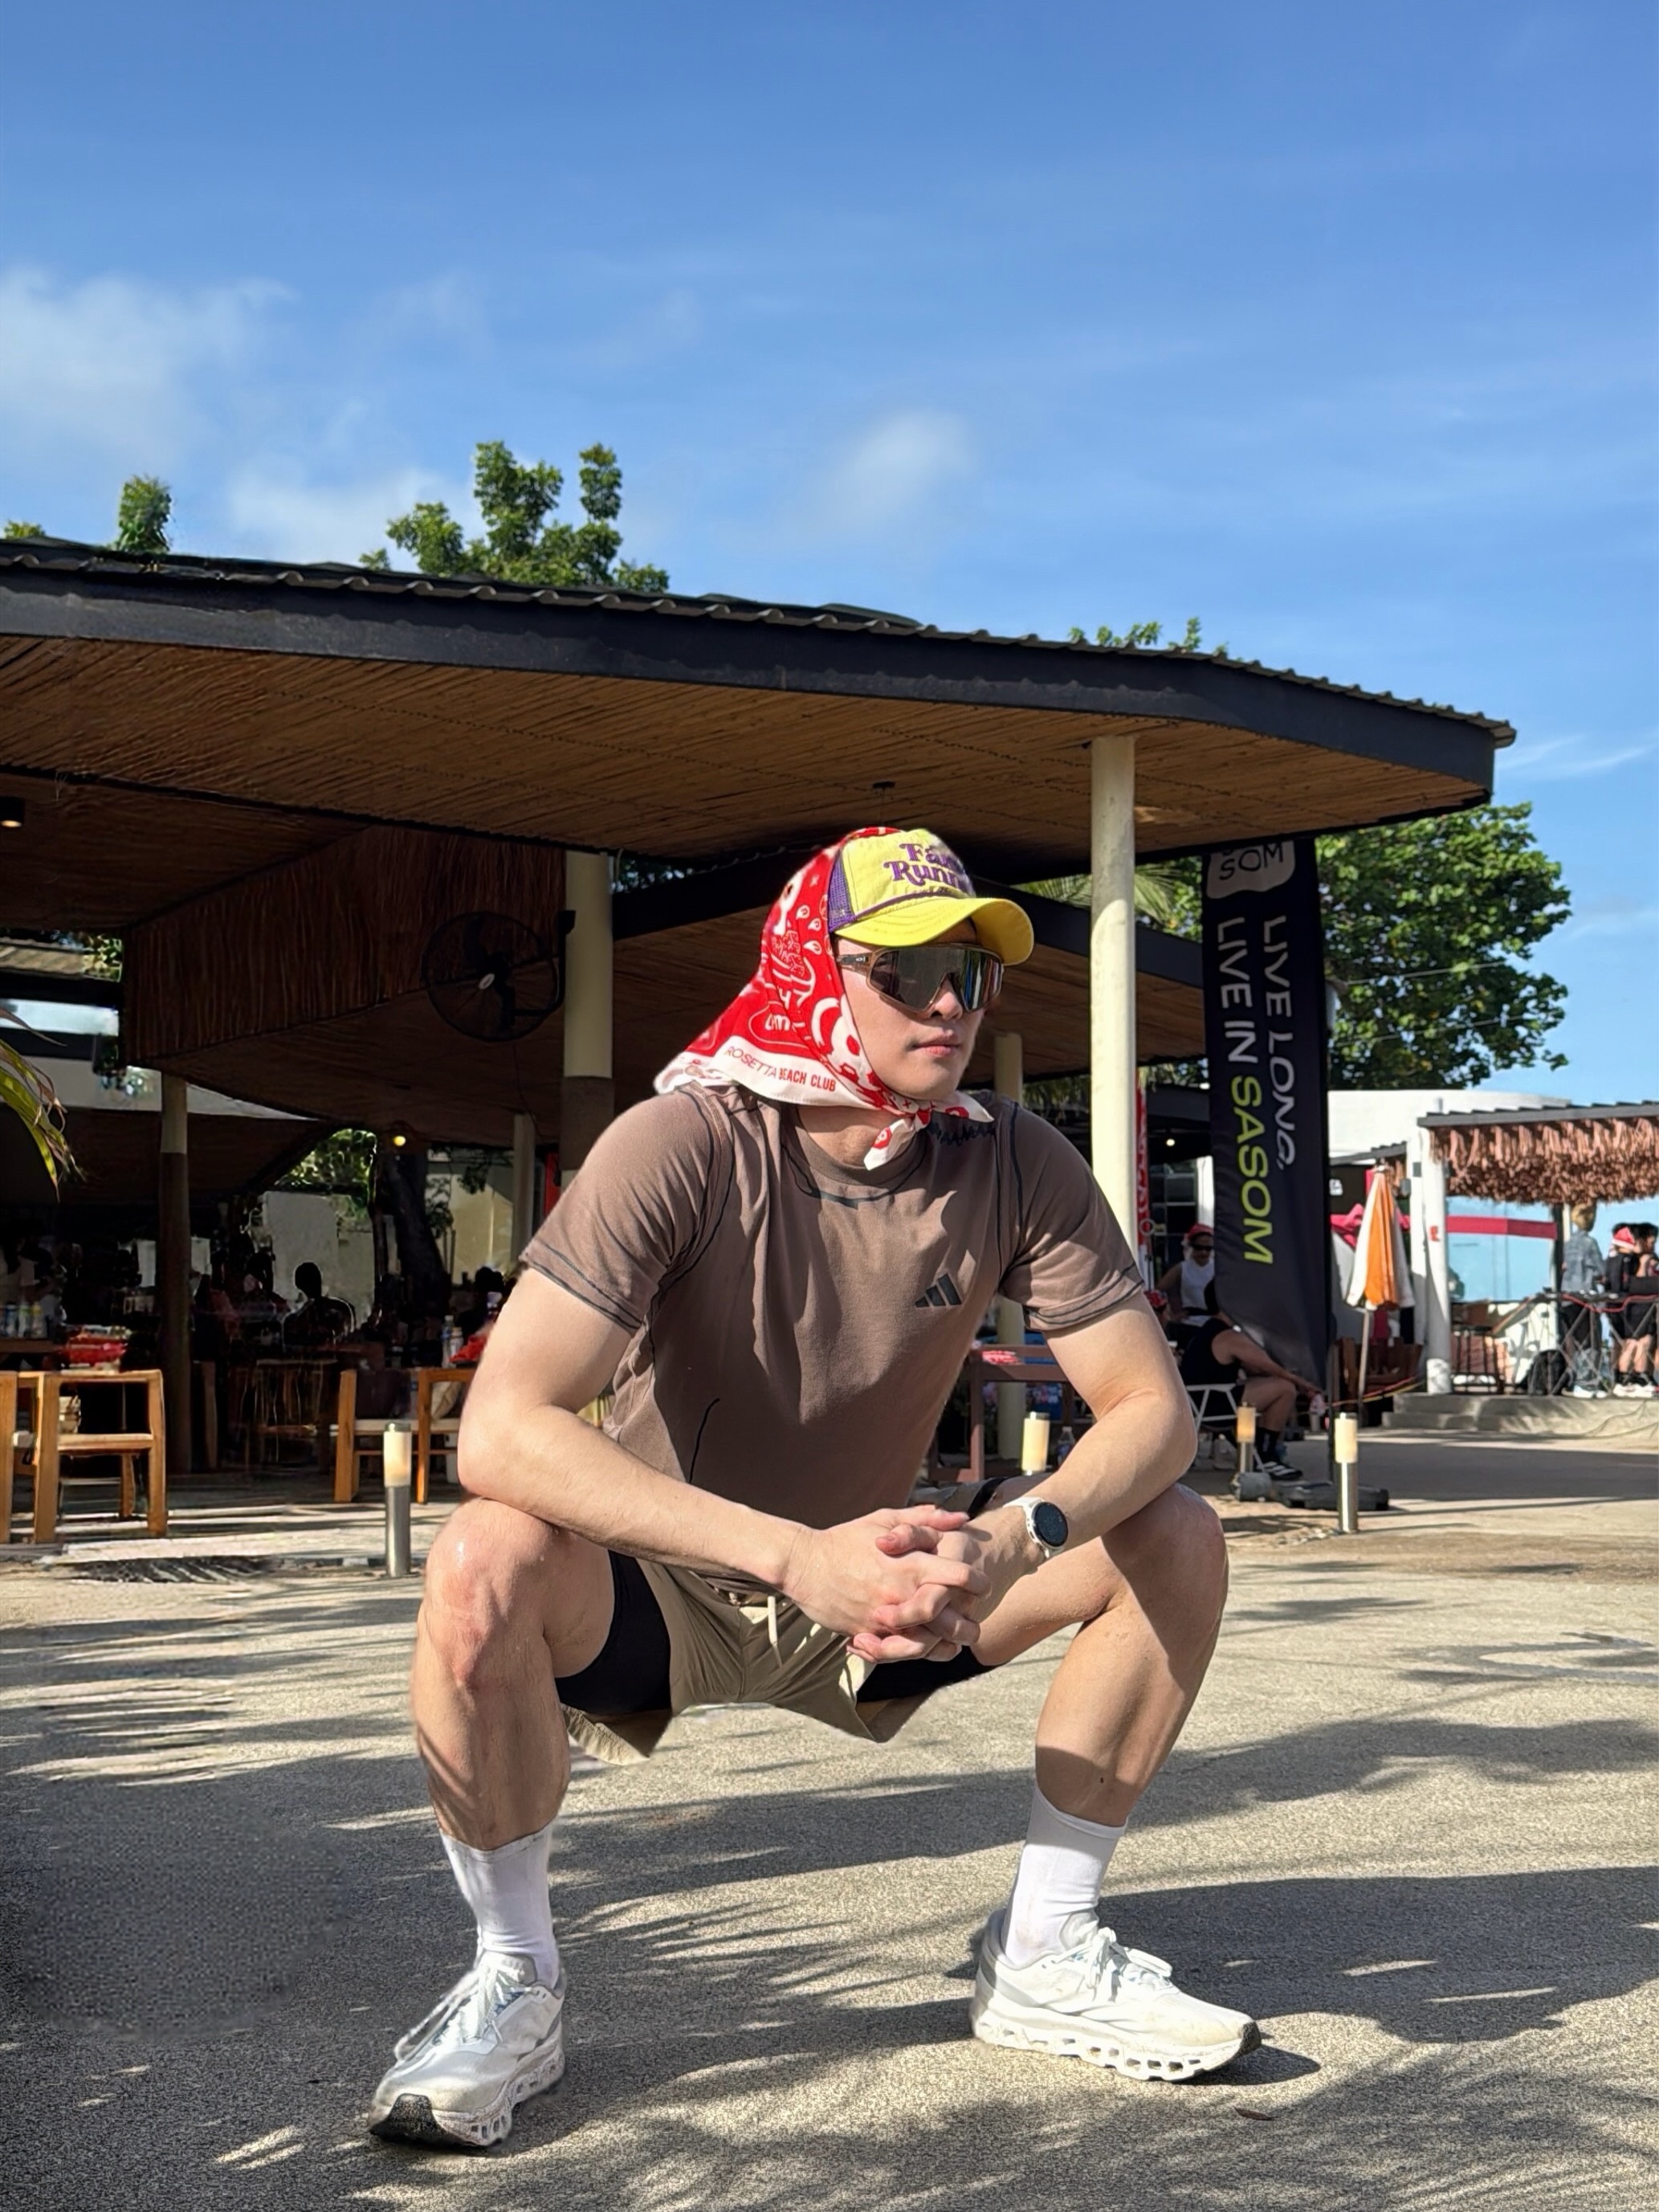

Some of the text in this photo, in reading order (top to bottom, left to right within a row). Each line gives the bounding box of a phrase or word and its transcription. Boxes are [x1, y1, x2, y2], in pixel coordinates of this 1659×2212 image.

[1218, 842, 1284, 880] SOM
[1264, 916, 1292, 1017] LIVE
[779, 1067, 807, 1085] BEACH
[810, 1075, 836, 1092] CLUB
[1217, 916, 1274, 1264] LIVE IN SASOM
